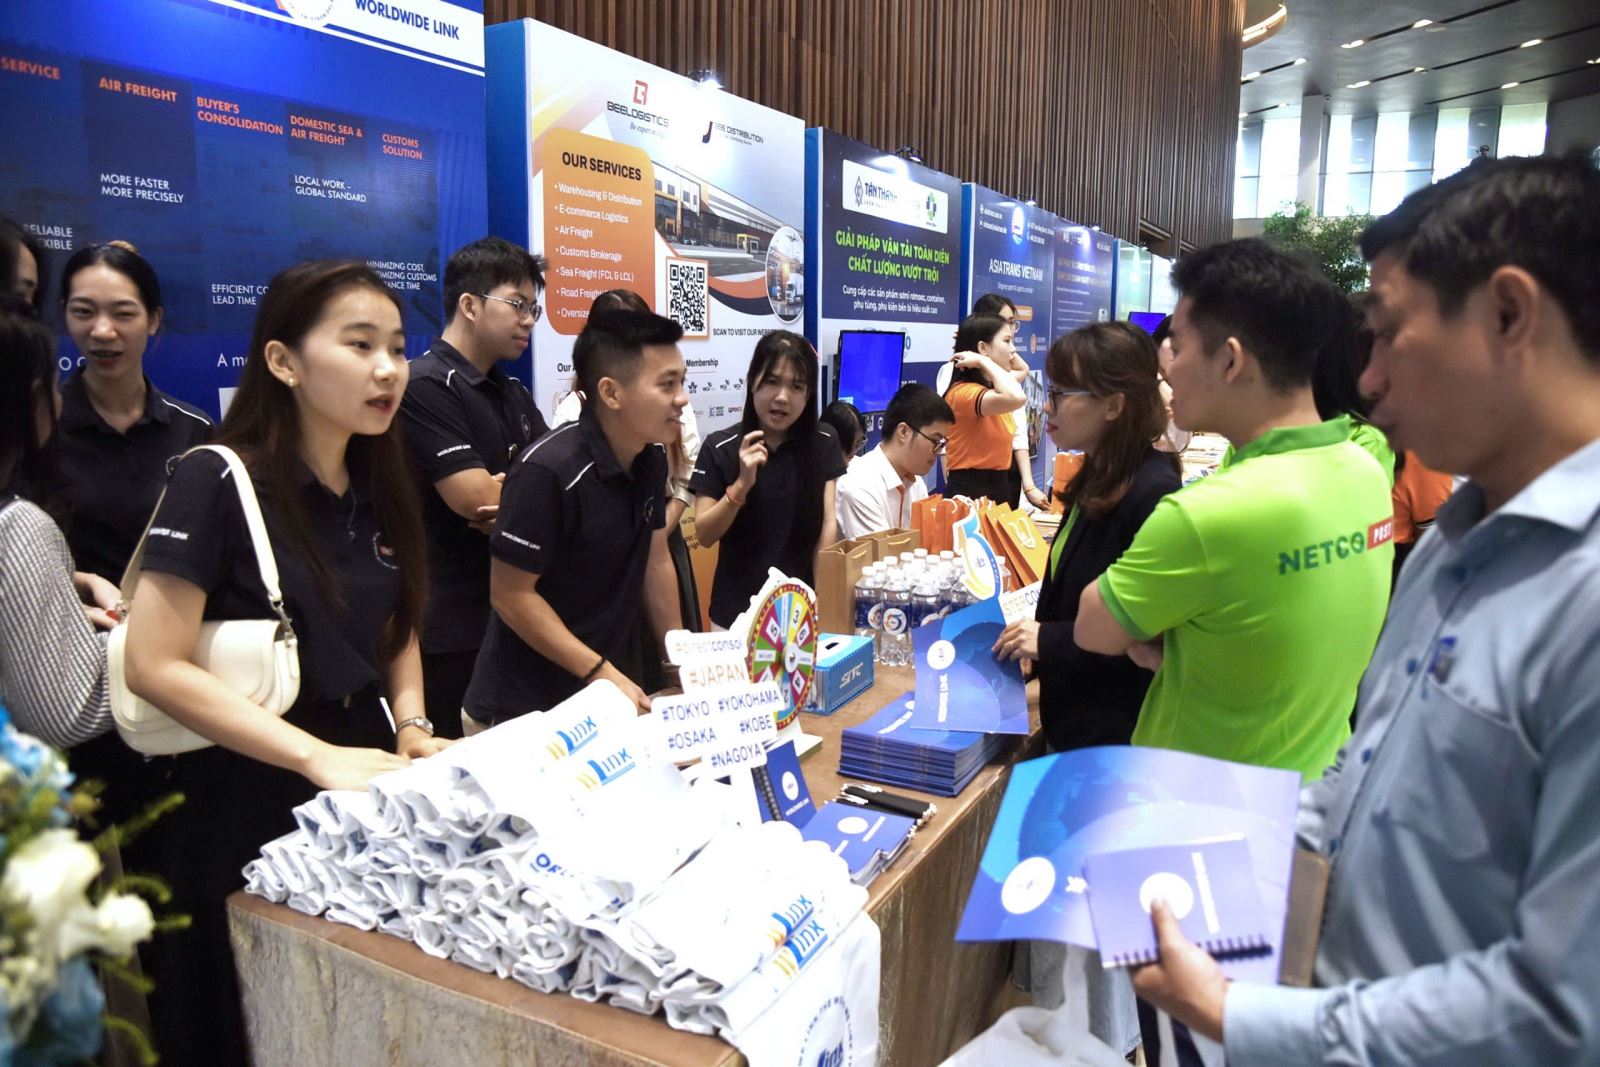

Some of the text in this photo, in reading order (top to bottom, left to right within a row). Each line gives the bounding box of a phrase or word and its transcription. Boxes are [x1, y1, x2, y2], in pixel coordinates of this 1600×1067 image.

[355, 0, 430, 31] WORLDWIDE
[433, 19, 460, 40] LINK
[0, 56, 61, 80] SERVICE
[99, 77, 178, 102] AIR FREIGHT
[196, 97, 240, 114] BUYER'S
[607, 101, 669, 127] BEELOGISTICS
[197, 111, 283, 135] CONSOLIDATION
[290, 115, 363, 138] DOMESTIC SEA &
[290, 129, 346, 146] AIR FREIGHT
[382, 134, 419, 148] CUSTOMS
[383, 145, 423, 160] SOLUTION
[562, 151, 642, 181] OUR SERVICES
[101, 173, 170, 190] MORE FASTER
[295, 175, 320, 187] LOCAL
[322, 178, 345, 190] WORK
[102, 187, 184, 203] MORE PRECISELY
[295, 186, 367, 203] GLOBAL STANDARD
[558, 183, 601, 202] Warehousing
[608, 192, 642, 207] Distribution
[559, 204, 630, 224] E-commerce Logistics
[560, 225, 593, 239] Air Freight
[560, 246, 622, 262] Customs Brokerage
[857, 233, 880, 251] PHÁP
[882, 237, 899, 258] VẬN
[366, 260, 405, 270] MINIMIZING
[560, 267, 574, 277] Sea
[574, 268, 597, 280] Freight
[848, 253, 872, 272] CHẤT
[873, 259, 900, 279] LƯỢNG
[406, 272, 437, 281] CUSTOMS
[212, 284, 254, 294] EFFICIENT
[406, 281, 420, 290] TIME
[560, 288, 579, 298] Road
[213, 296, 256, 305] LEAD TIME
[713, 328, 727, 336] SCAN
[557, 363, 571, 372] Our
[686, 358, 718, 368] Membership
[1278, 531, 1365, 575] NETCO
[690, 664, 745, 687] #JAPAN
[662, 689, 779, 721] #TOKYO #YOKOHAMA
[668, 714, 772, 750] #OSAKA #KOBE
[710, 743, 762, 767] #NAGOYA
